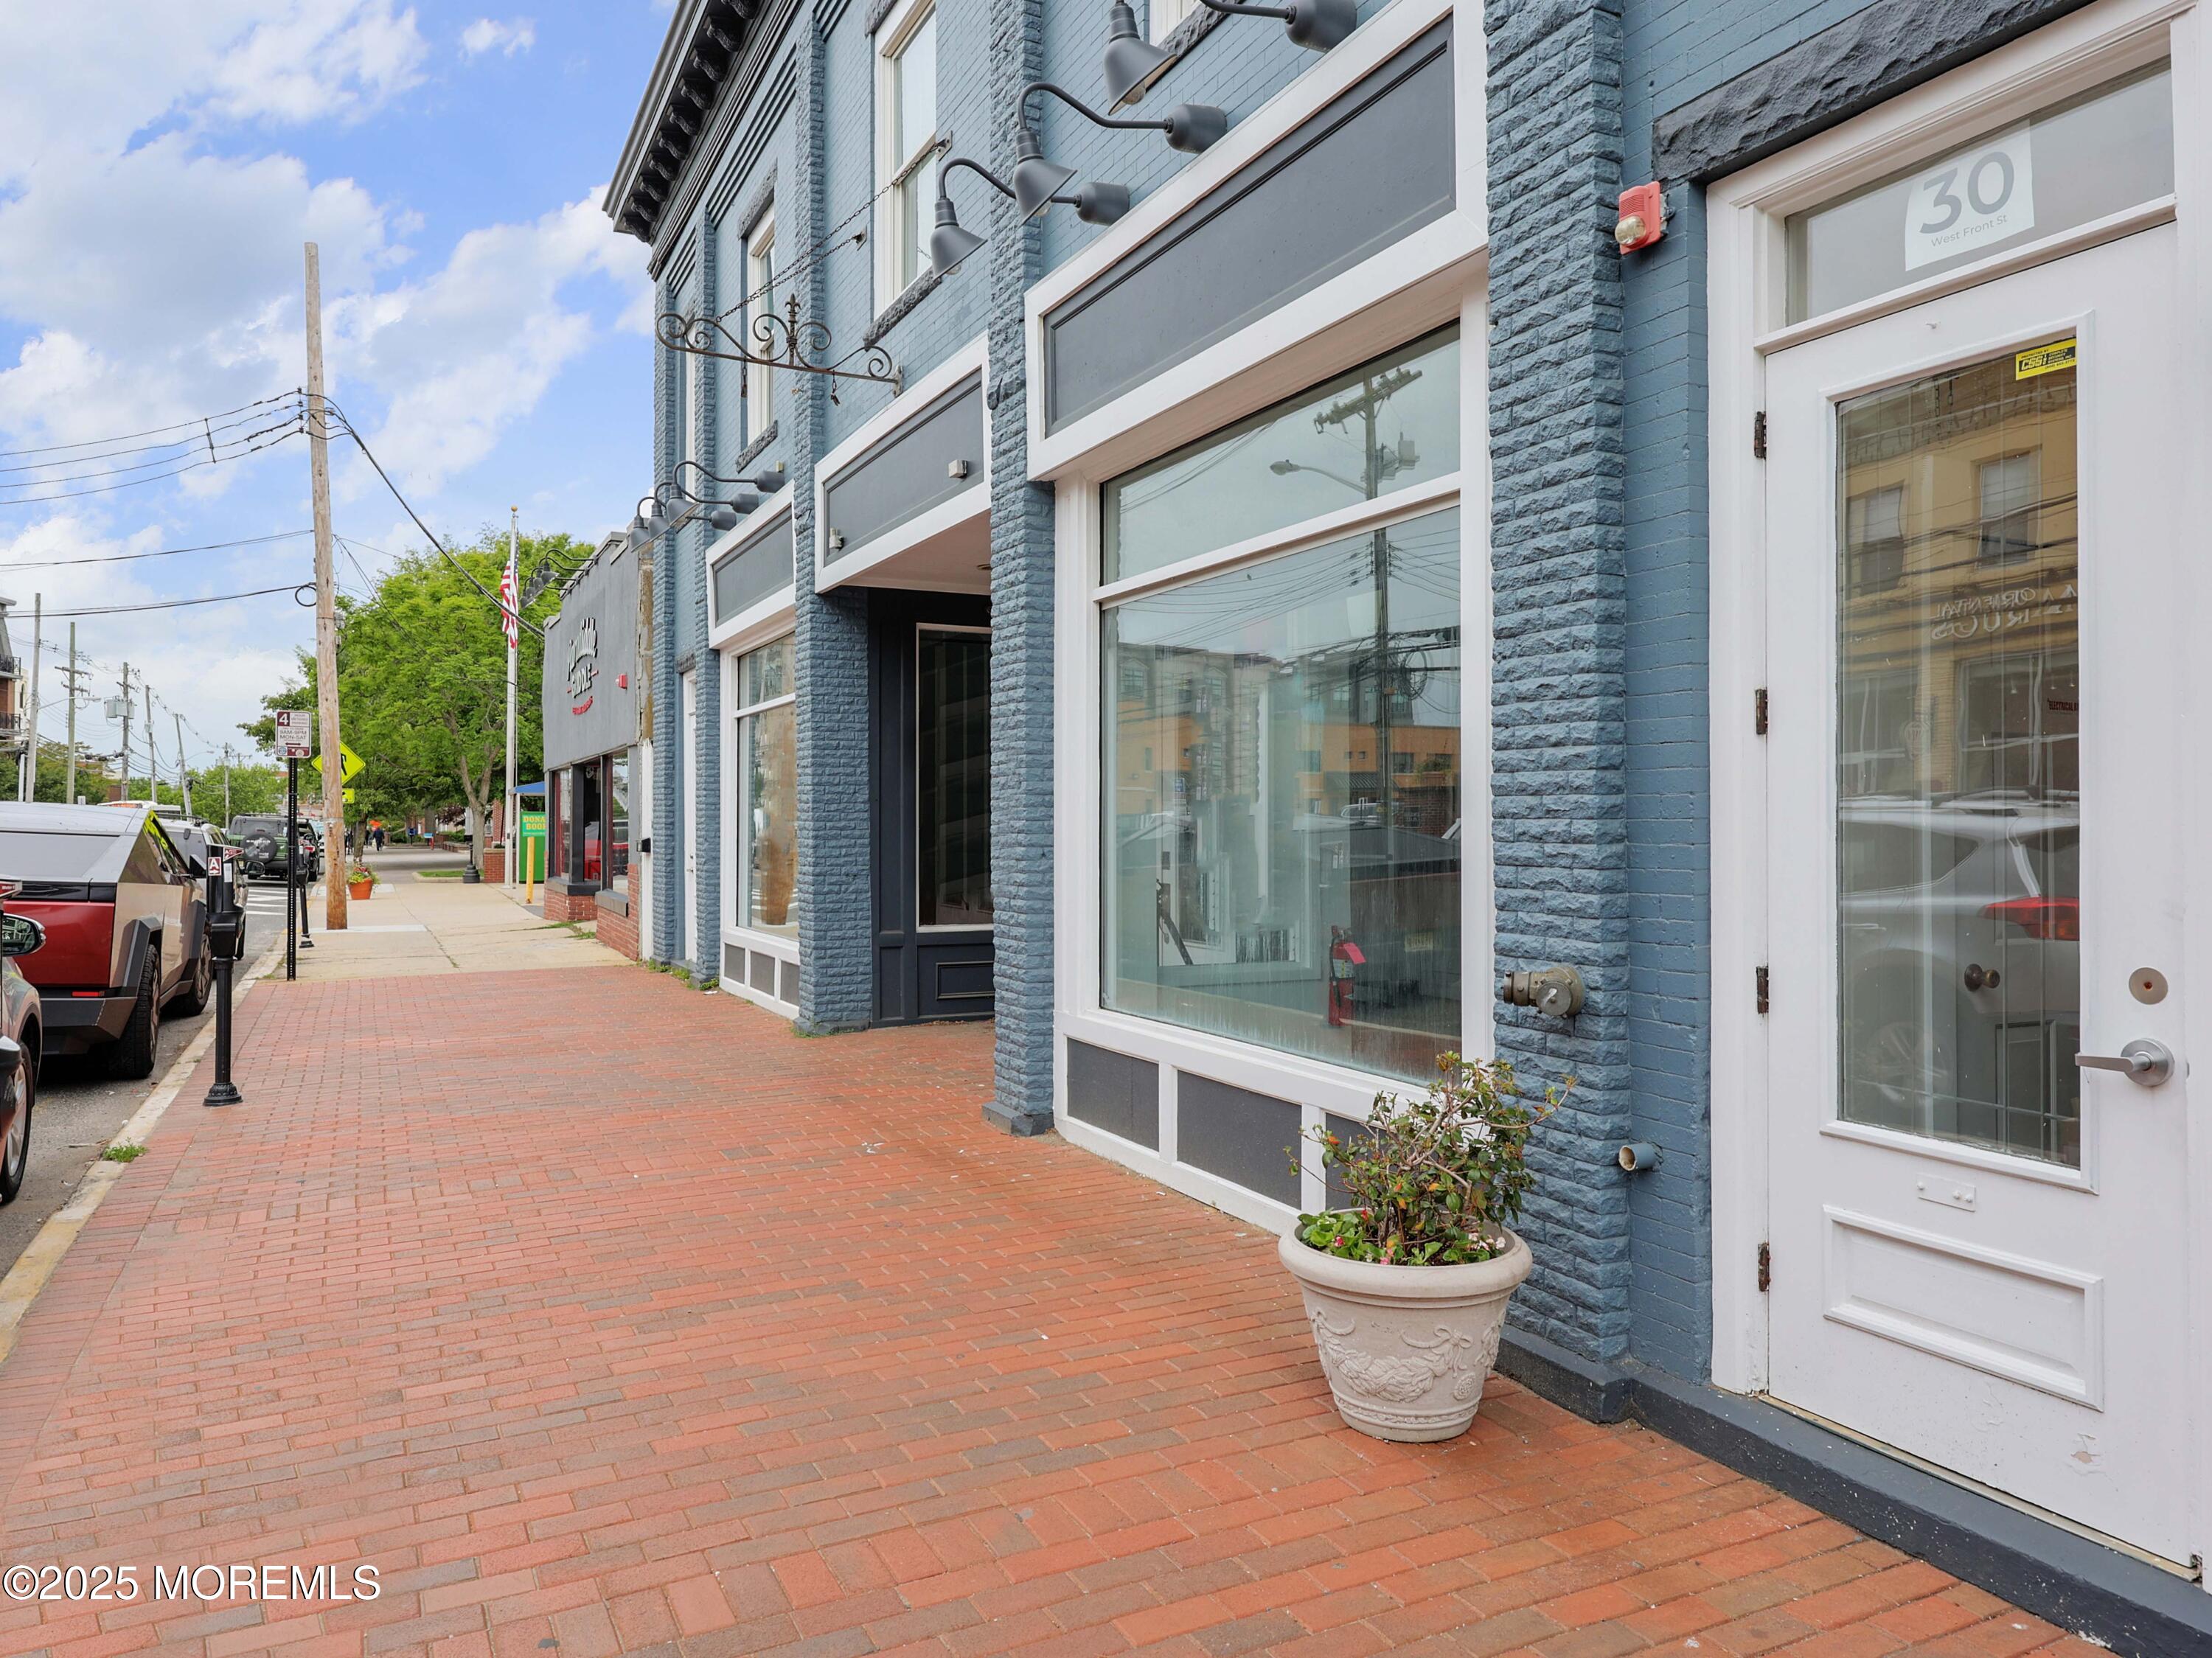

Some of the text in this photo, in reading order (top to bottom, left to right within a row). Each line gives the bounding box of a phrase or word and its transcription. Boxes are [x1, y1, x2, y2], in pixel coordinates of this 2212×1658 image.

[1920, 152, 2014, 234] 30
[1931, 215, 2008, 247] West Front St
[279, 713, 289, 725] 4
[209, 858, 219, 869] A
